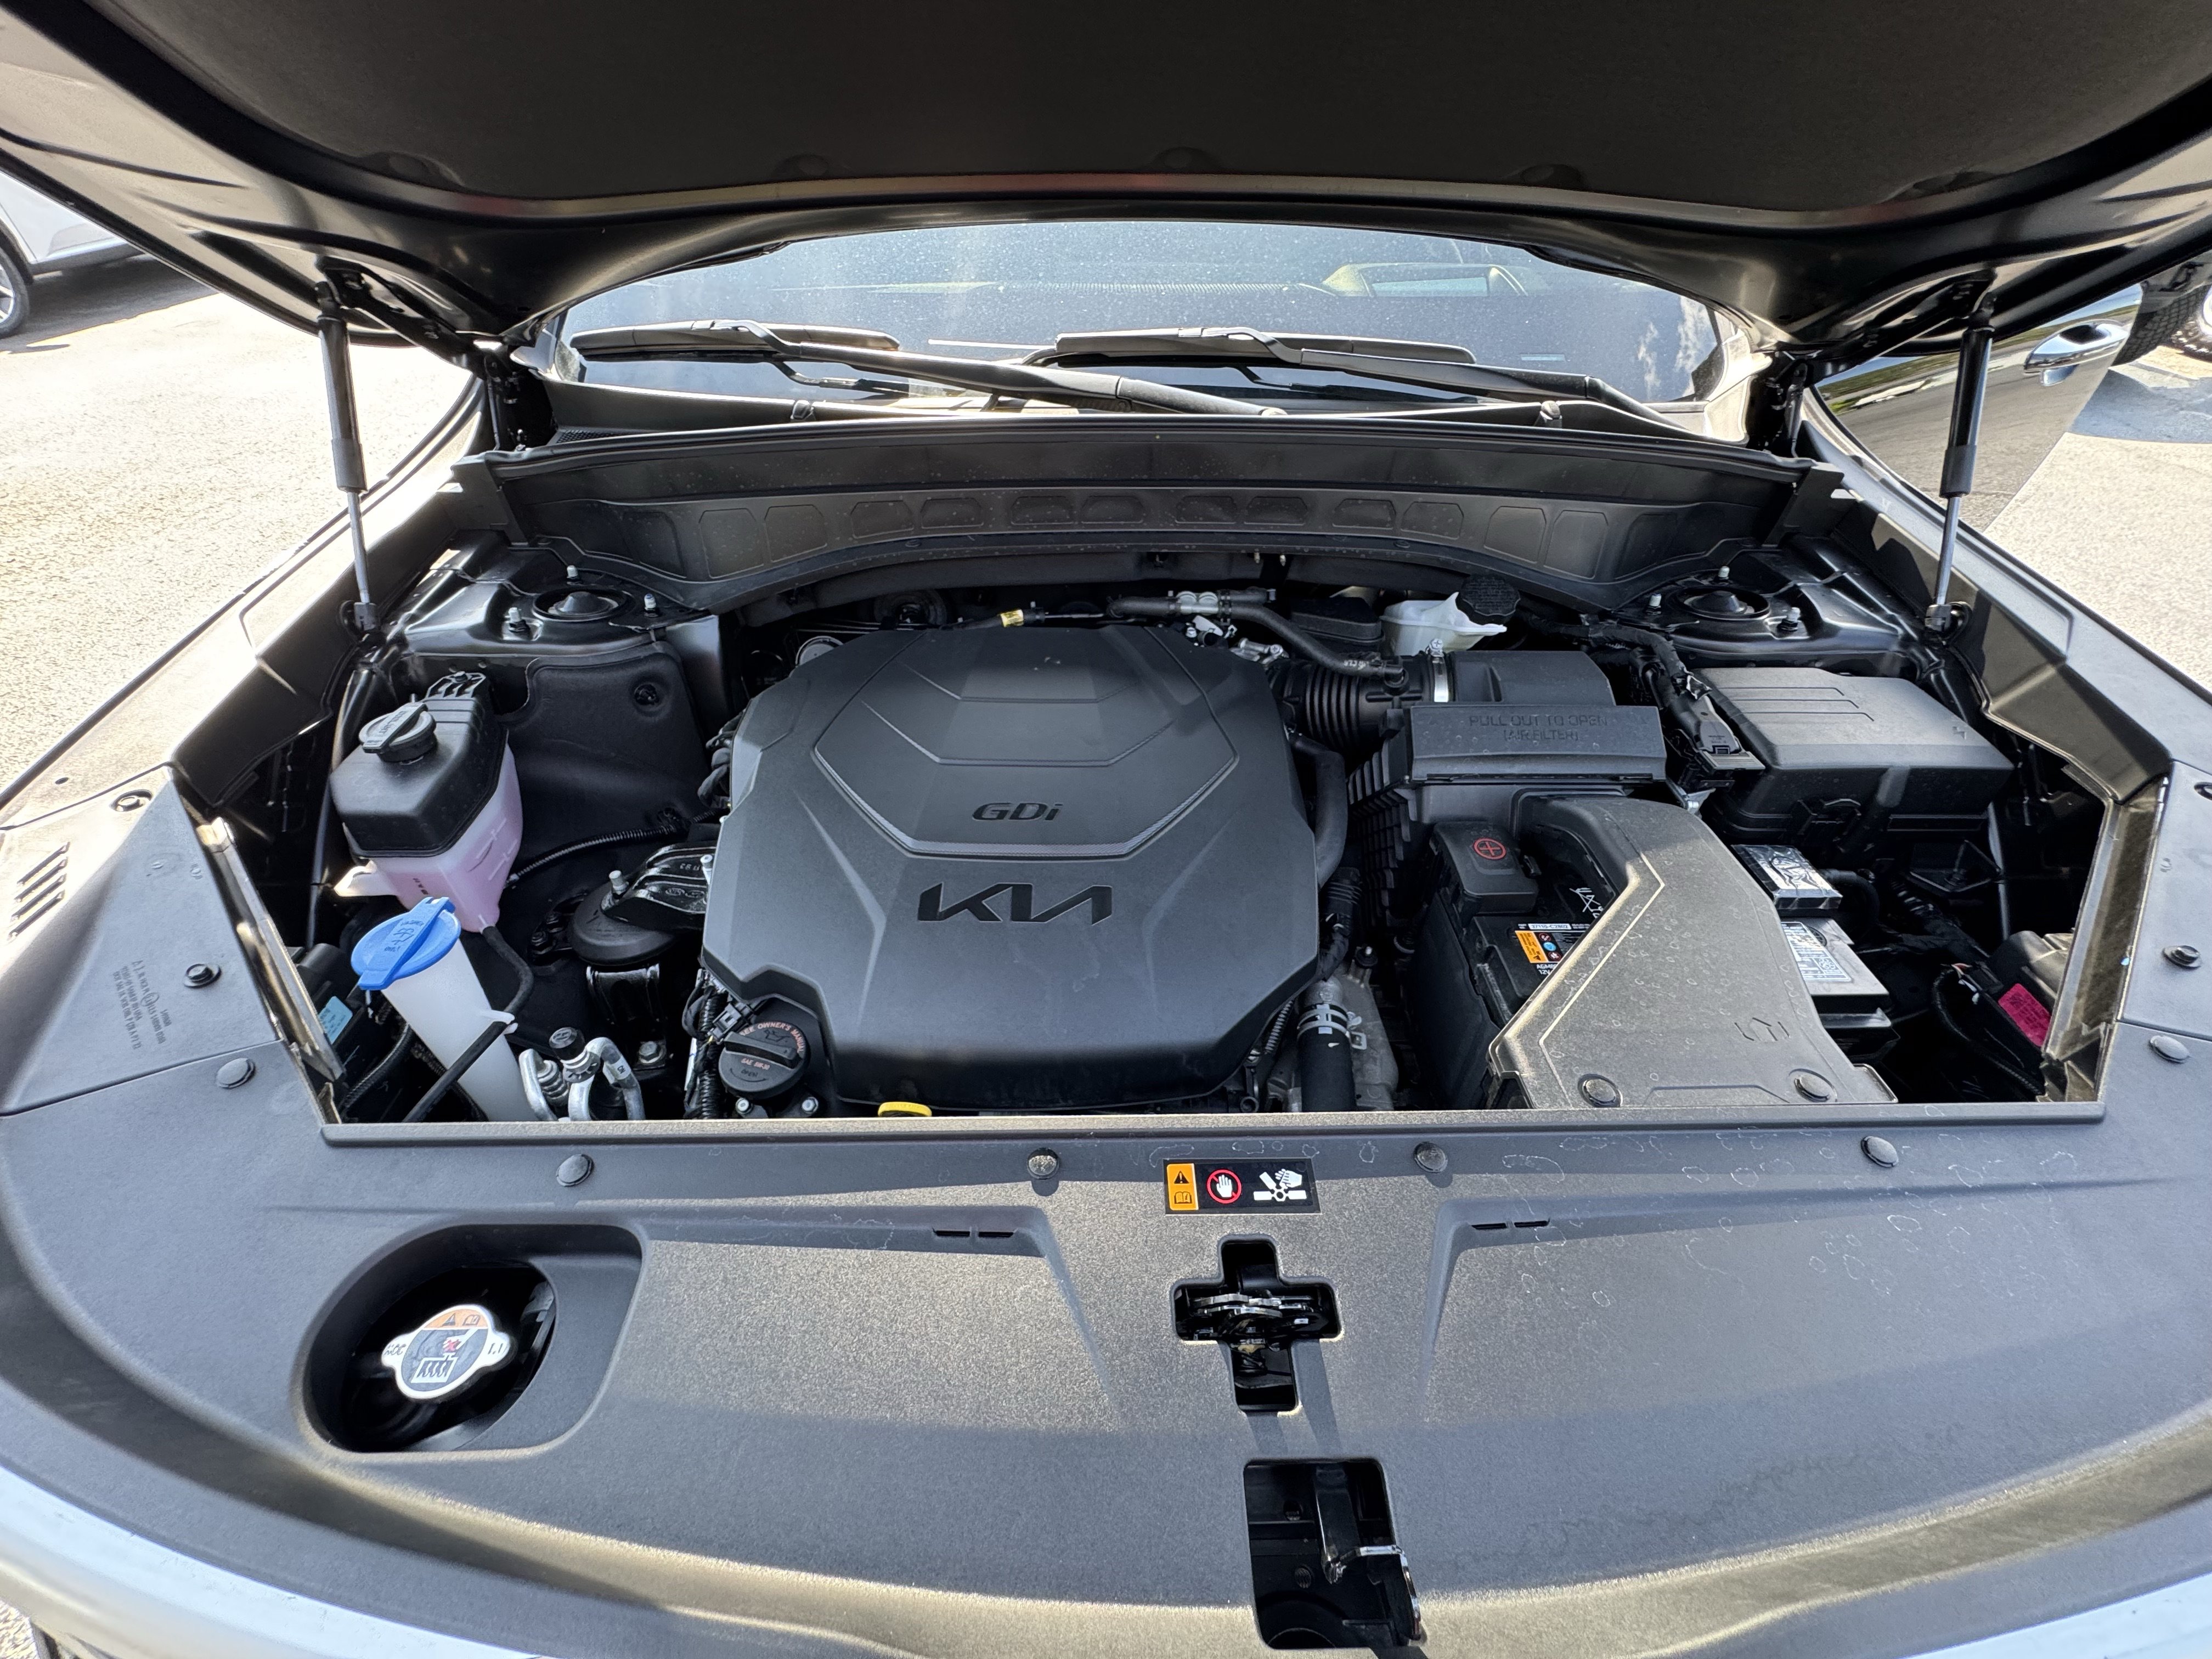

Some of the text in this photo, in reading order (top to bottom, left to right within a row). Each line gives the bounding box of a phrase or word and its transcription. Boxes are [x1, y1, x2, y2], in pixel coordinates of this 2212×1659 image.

[1469, 715, 1607, 726] PULL OUT TO OPEN
[972, 802, 1063, 821] GDi
[917, 882, 1112, 926] KIA
[757, 1022, 792, 1031] OWNER'S
[790, 1029, 806, 1054] MANUAL
